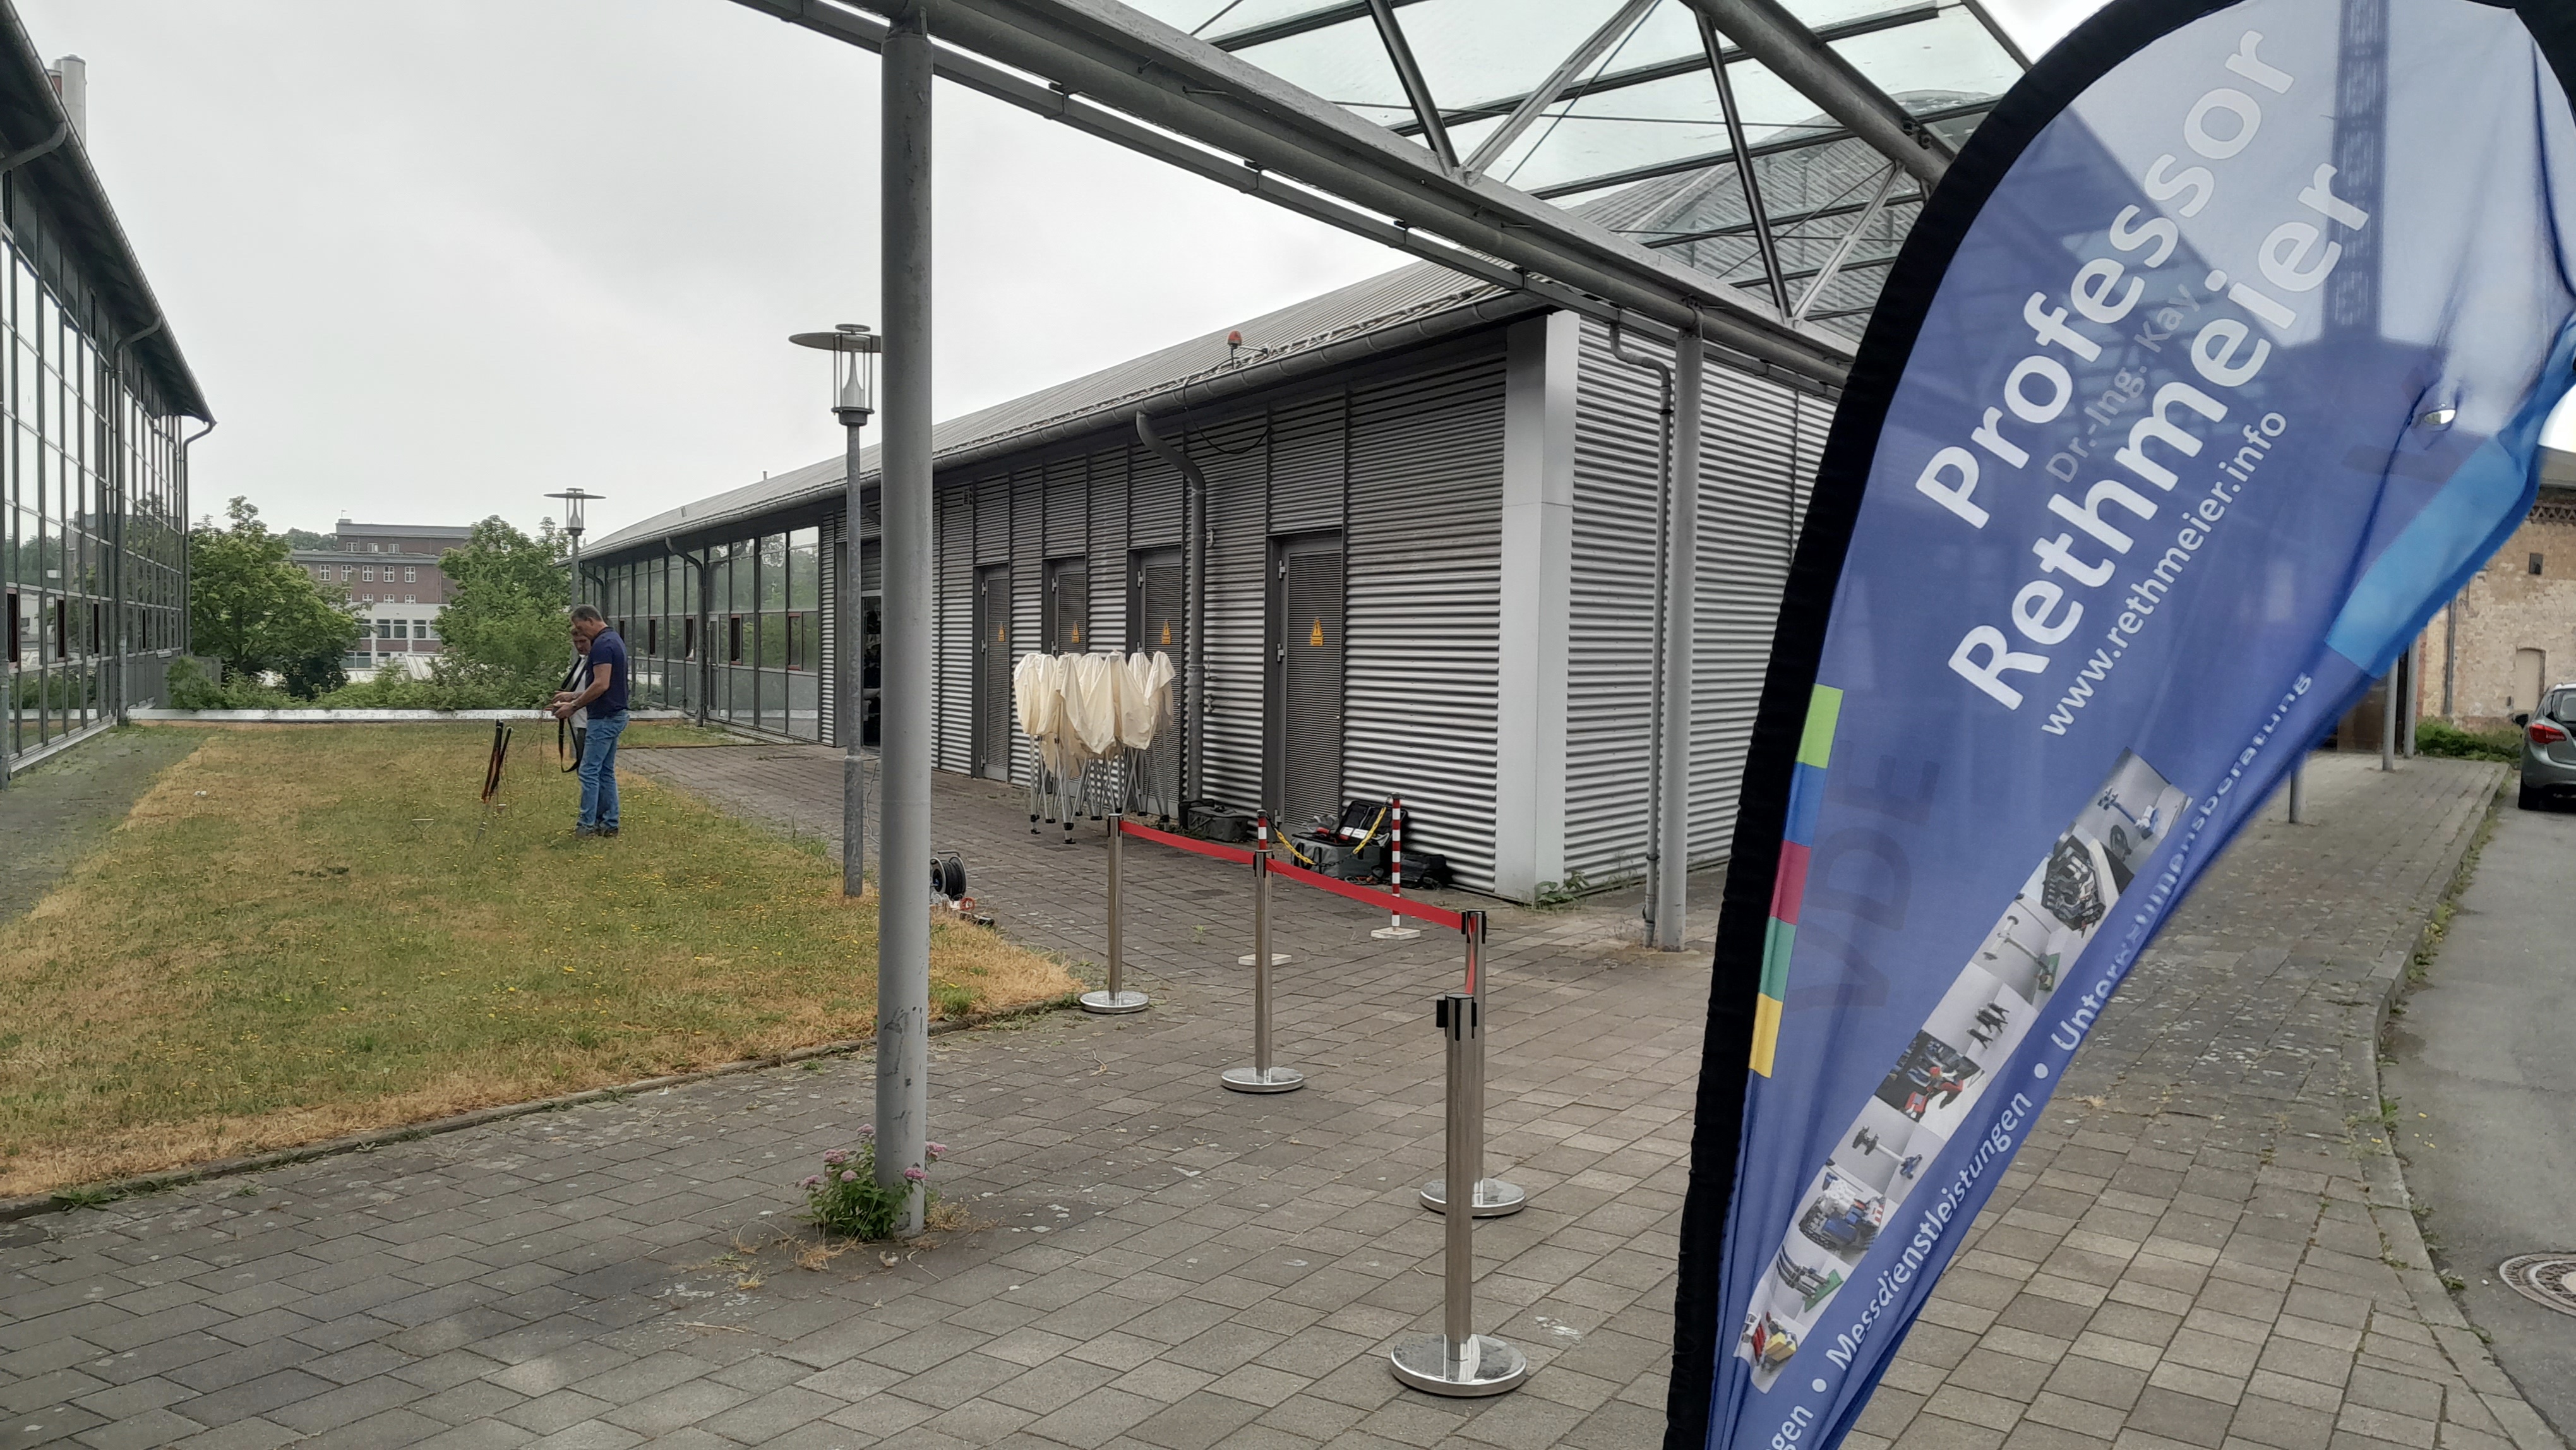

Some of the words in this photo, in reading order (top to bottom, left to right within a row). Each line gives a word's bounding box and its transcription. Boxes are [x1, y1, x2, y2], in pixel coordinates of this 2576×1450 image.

[1915, 30, 2294, 529] Professor
[1948, 163, 2369, 711] Rethmeier
[2046, 364, 2147, 484] Dr.-Ing.
[2134, 282, 2201, 354] Kay
[2041, 412, 2287, 736] www.rethmeier.info
[1765, 1405, 1814, 1450] gen
[1826, 1091, 2034, 1372] Messdienstleistungen
